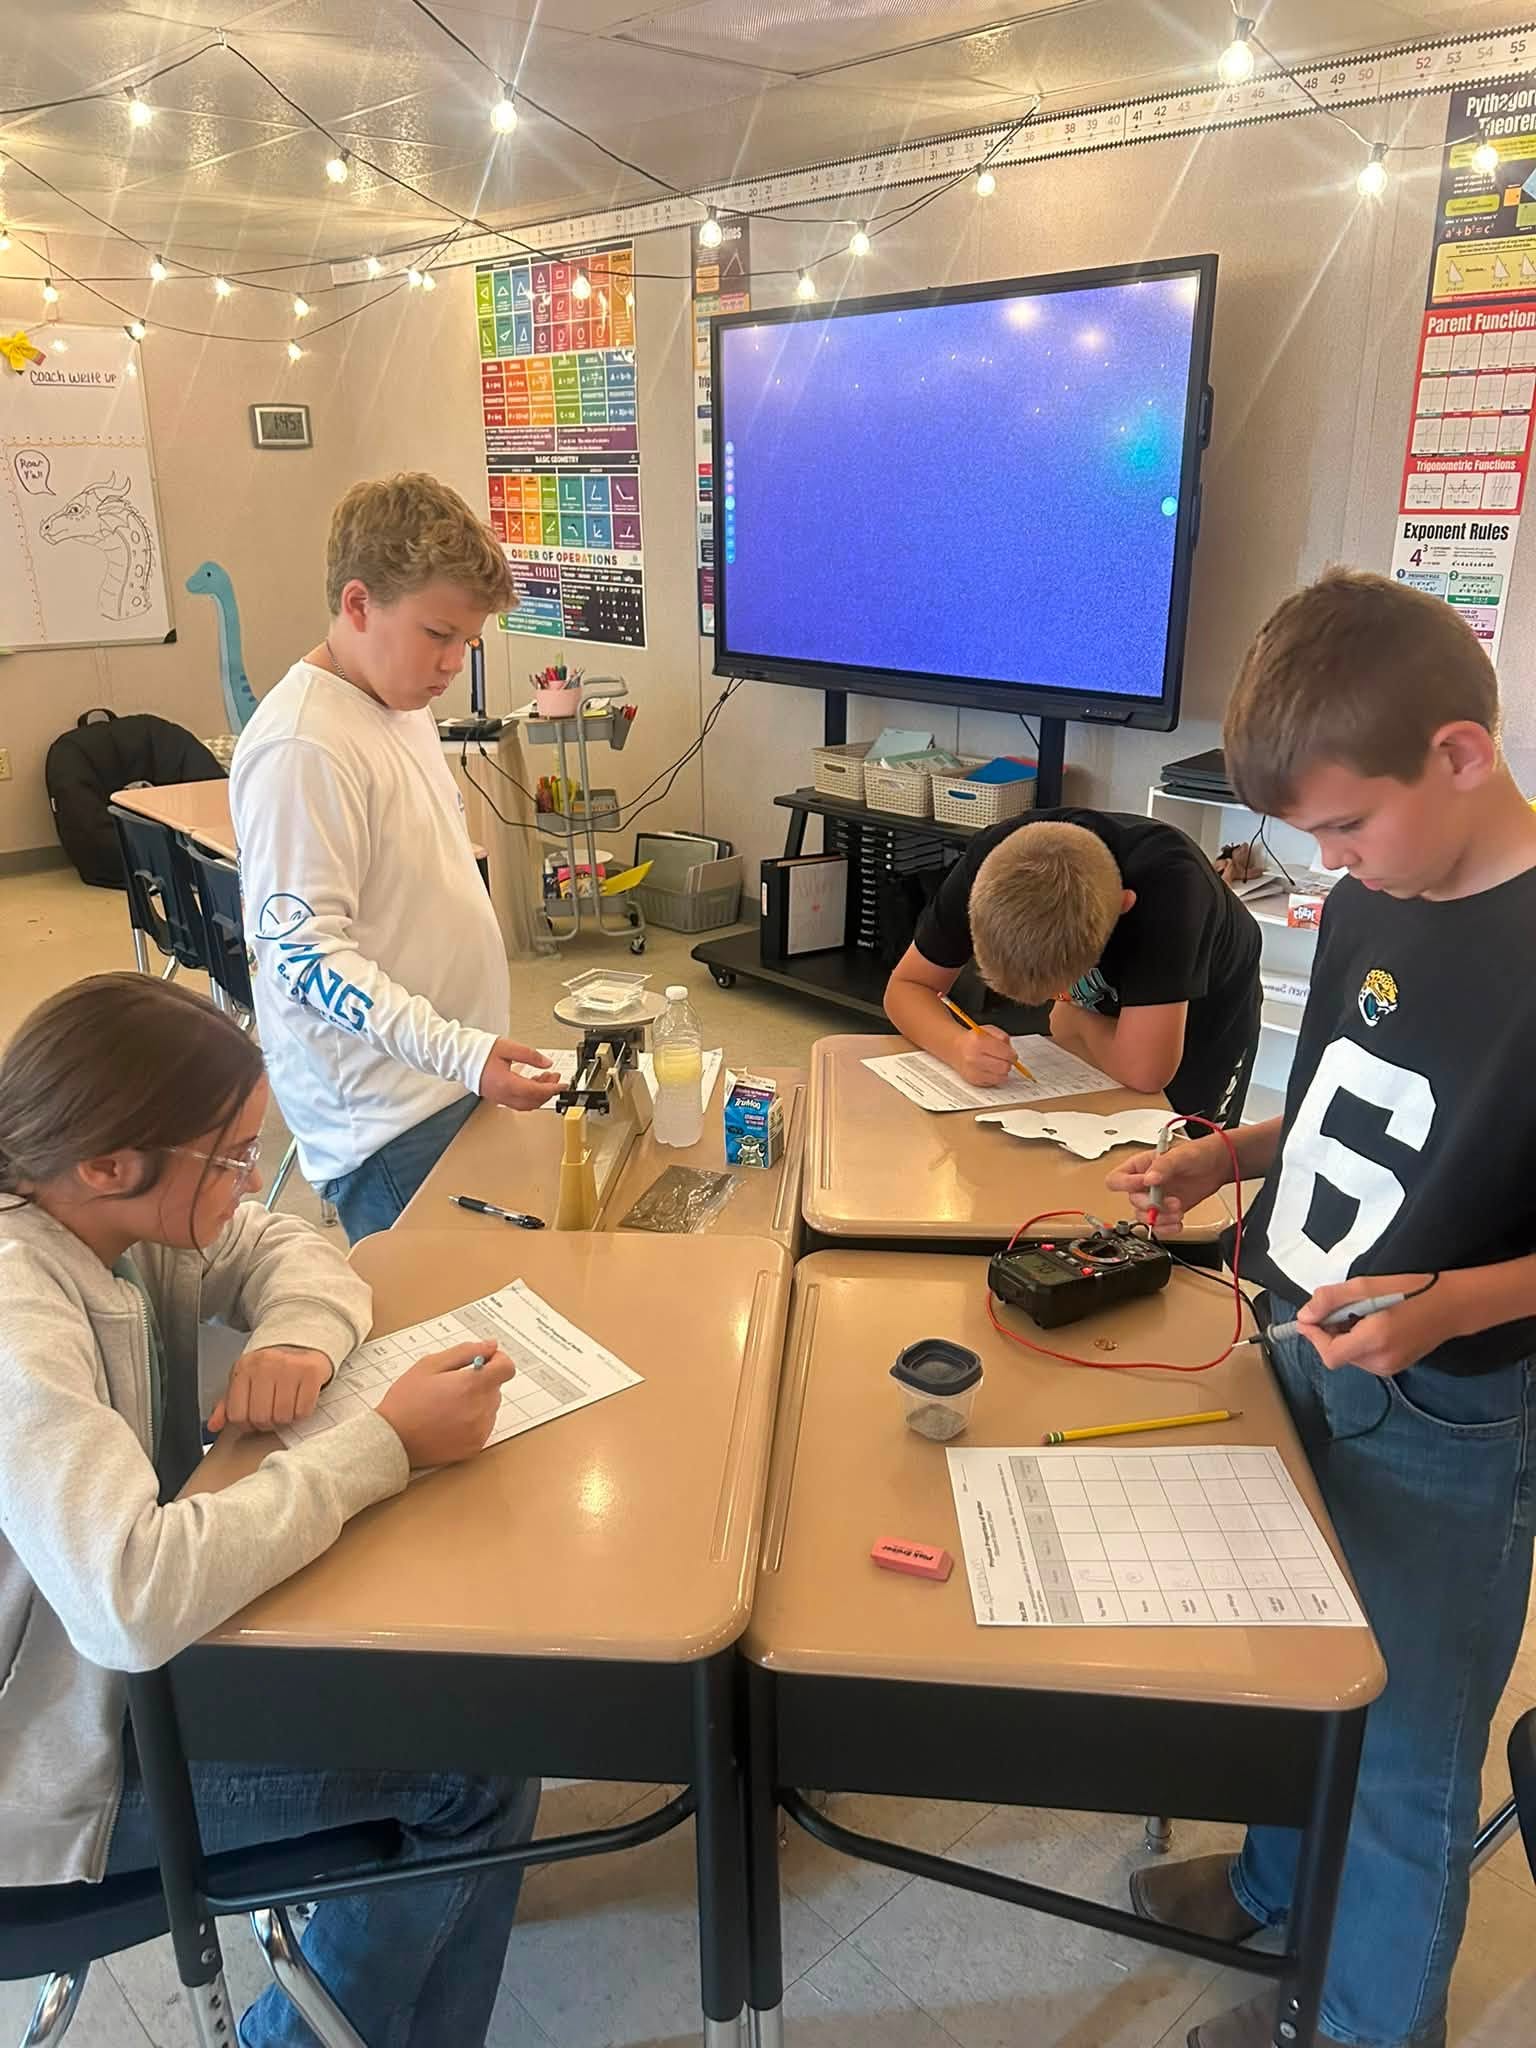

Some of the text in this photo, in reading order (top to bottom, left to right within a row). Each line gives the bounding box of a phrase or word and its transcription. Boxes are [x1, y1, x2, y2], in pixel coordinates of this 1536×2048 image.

[858, 165, 867, 175] 27
[930, 150, 938, 160] 31
[983, 139, 994, 149] 34
[1064, 123, 1076, 134] 38
[1087, 119, 1098, 130] 39
[1107, 115, 1121, 126] 40
[1132, 110, 1143, 121] 41
[1153, 105, 1167, 117] 42
[1177, 101, 1191, 112] 43
[1226, 92, 1240, 104] 45
[1251, 88, 1265, 99] 46
[1278, 82, 1292, 94] 47
[1303, 77, 1319, 90] 48
[1330, 72, 1346, 85] 49
[1357, 68, 1374, 81] 50
[1415, 57, 1432, 70] 52
[1446, 51, 1462, 65] 53
[1477, 46, 1493, 60] 54
[1509, 40, 1526, 54] 55
[1427, 313, 1472, 334] Parent
[1416, 459, 1516, 472] Trigonometric Functions
[1403, 522, 1510, 541] Exponent Rules
[511, 549, 618, 565] ORDER OF OPERATIONS
[1266, 1036, 1437, 1296] 6
[913, 1551, 934, 1561] Pink
